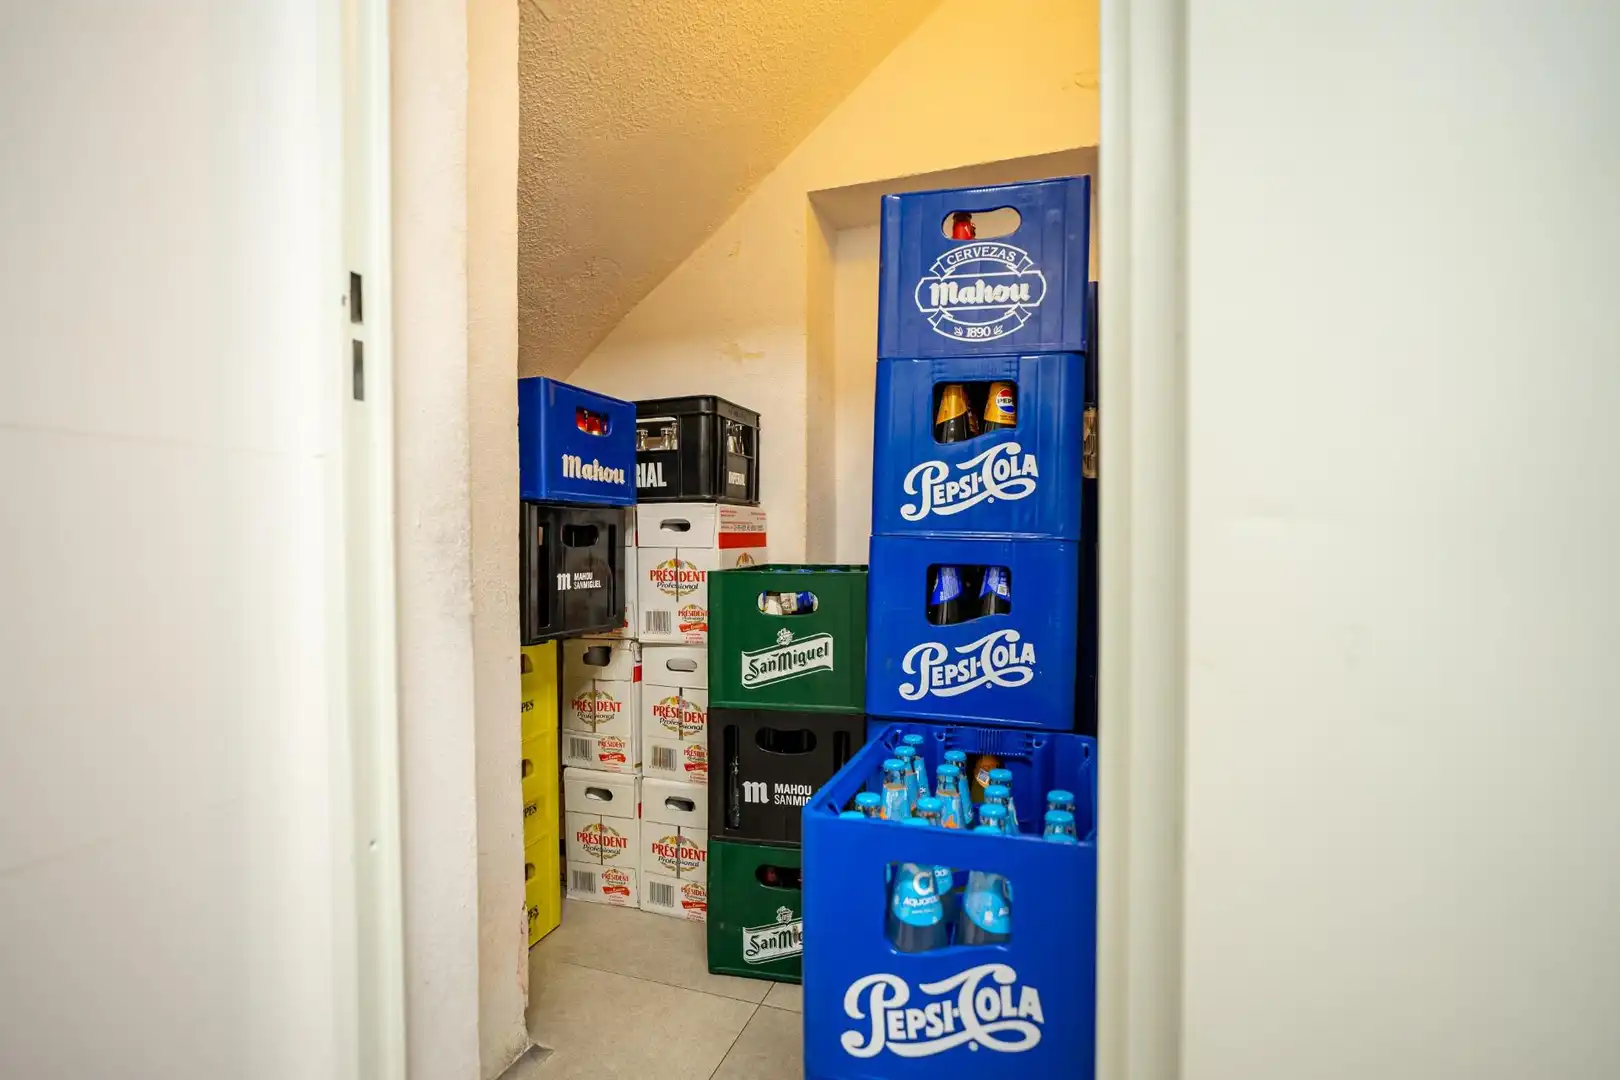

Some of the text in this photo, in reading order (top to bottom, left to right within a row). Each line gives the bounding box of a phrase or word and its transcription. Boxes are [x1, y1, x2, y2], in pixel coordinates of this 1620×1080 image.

[946, 246, 1016, 265] CERVEZAS
[929, 279, 1031, 306] Mahou
[966, 327, 991, 337] 1890
[561, 453, 625, 485] Mahou
[573, 572, 593, 581] MAHOU
[650, 568, 706, 583] PRÉSIDENT
[571, 699, 622, 713] PRÉSDENT
[774, 783, 812, 796] MAHOU
